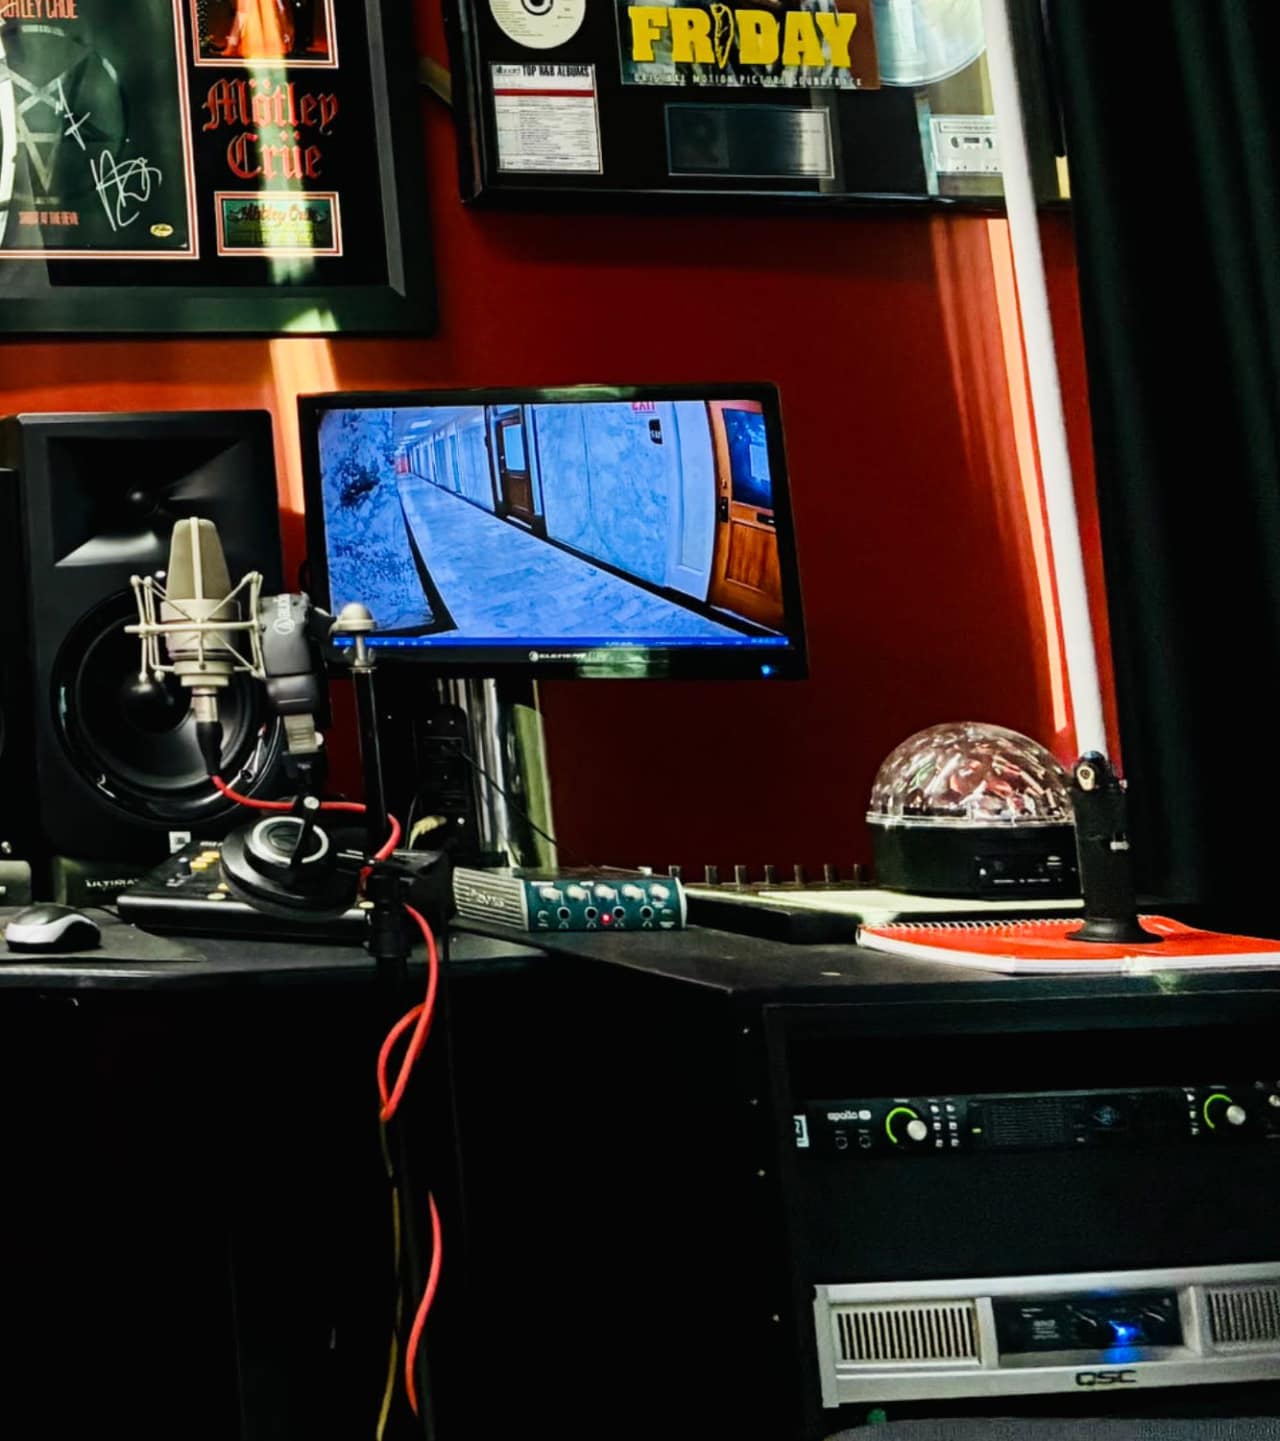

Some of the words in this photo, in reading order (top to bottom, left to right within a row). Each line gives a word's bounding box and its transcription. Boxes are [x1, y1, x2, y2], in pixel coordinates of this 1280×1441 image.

[627, 3, 858, 70] FRIDAY
[201, 78, 340, 136] Mötley
[226, 130, 323, 180] Crüe
[85, 878, 140, 891] ULTIMA
[1075, 1368, 1138, 1387] QSC
